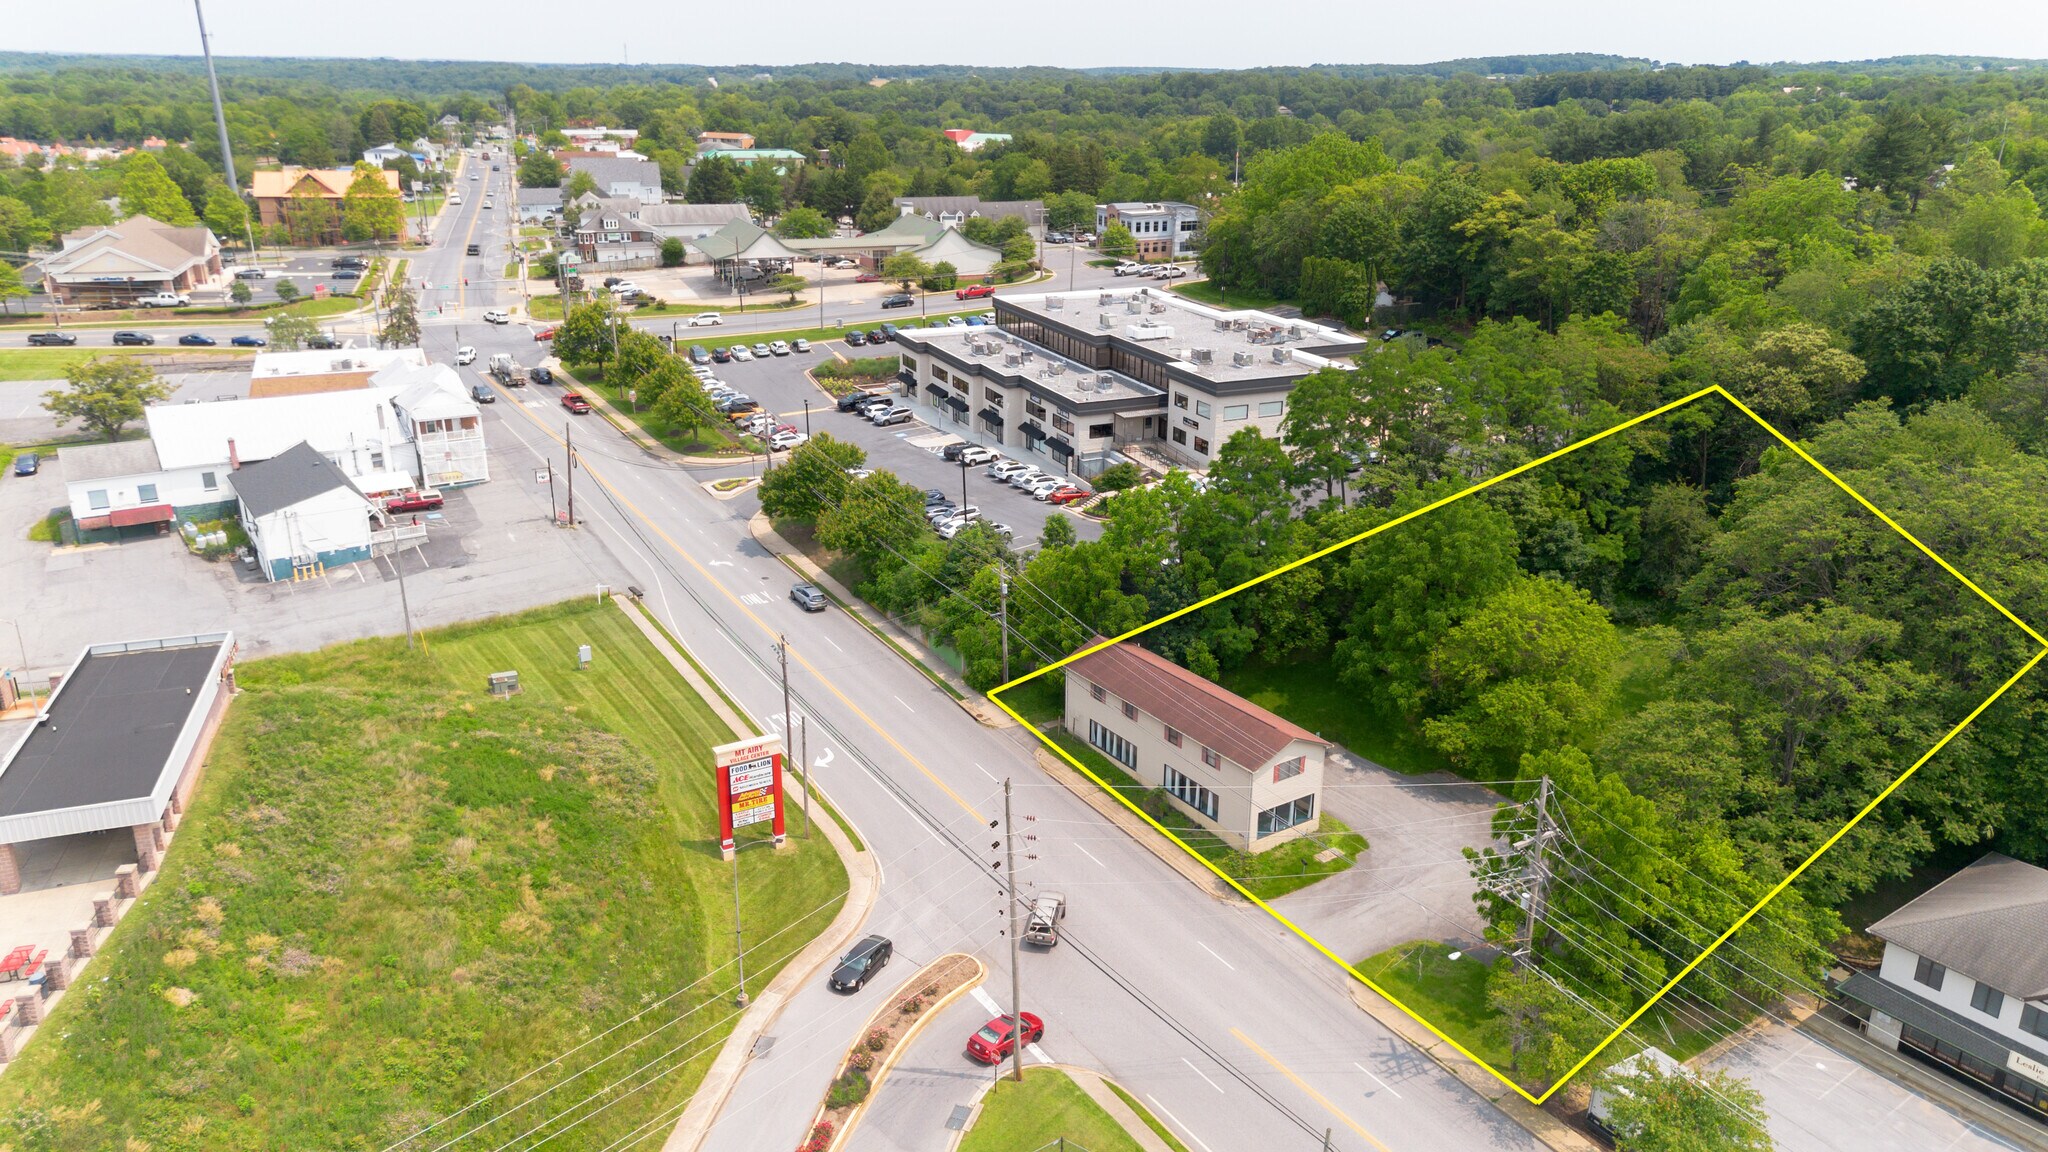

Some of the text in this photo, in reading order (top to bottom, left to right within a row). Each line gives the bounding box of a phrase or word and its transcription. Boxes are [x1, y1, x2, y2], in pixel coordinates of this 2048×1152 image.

[740, 591, 774, 605] ONLY
[730, 750, 769, 763] VILLAGE CENTER
[735, 745, 763, 757] MT AIRY
[731, 760, 771, 774] FOOD LION
[733, 774, 749, 783] ACE
[2016, 1056, 2045, 1075] Leslie
